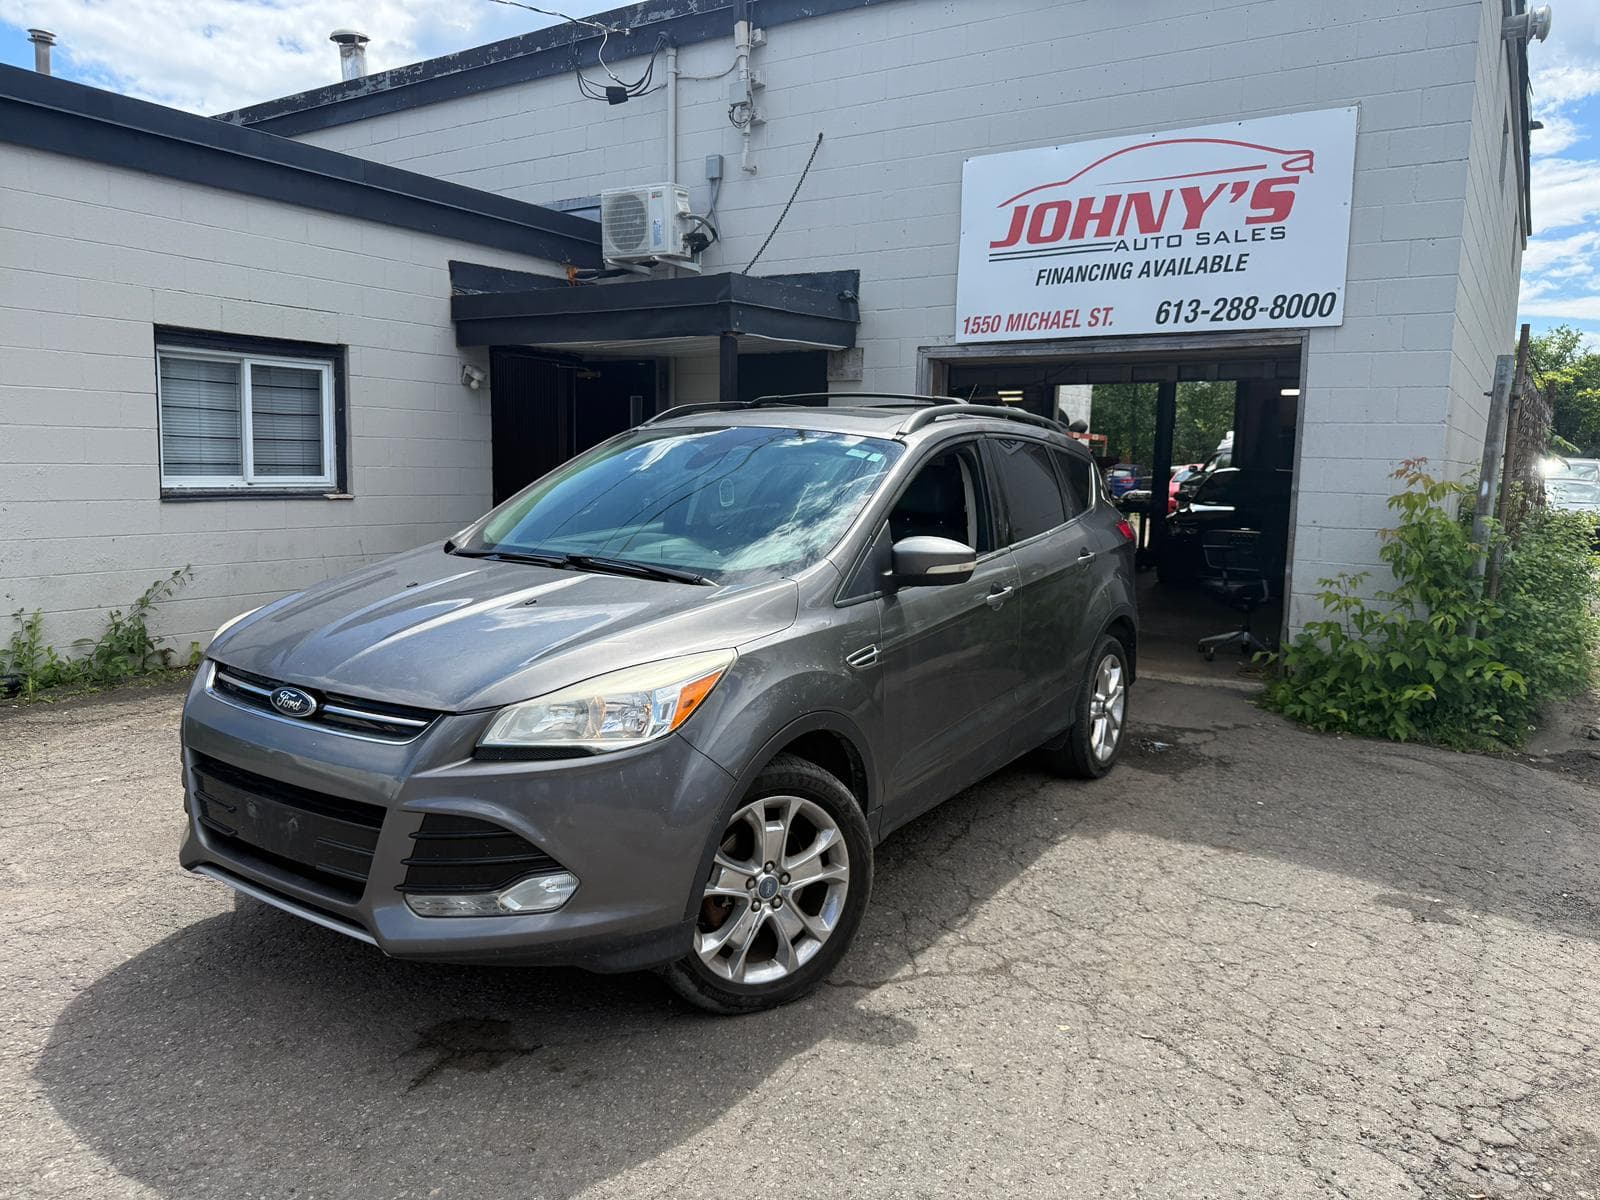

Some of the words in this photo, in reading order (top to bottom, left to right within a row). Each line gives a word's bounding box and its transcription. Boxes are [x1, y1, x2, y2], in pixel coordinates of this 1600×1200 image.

[989, 176, 1300, 249] JOHNY'S
[1114, 234, 1182, 252] AUTO
[1195, 226, 1286, 245] SALES
[1035, 261, 1133, 286] FINANCING
[1138, 253, 1250, 278] AVAILABLE
[963, 314, 1002, 335] 1550
[1005, 309, 1081, 332] MICHAEL
[1087, 307, 1114, 327] ST.
[1155, 292, 1337, 325] 613-288-8000
[276, 690, 303, 711] Ford
